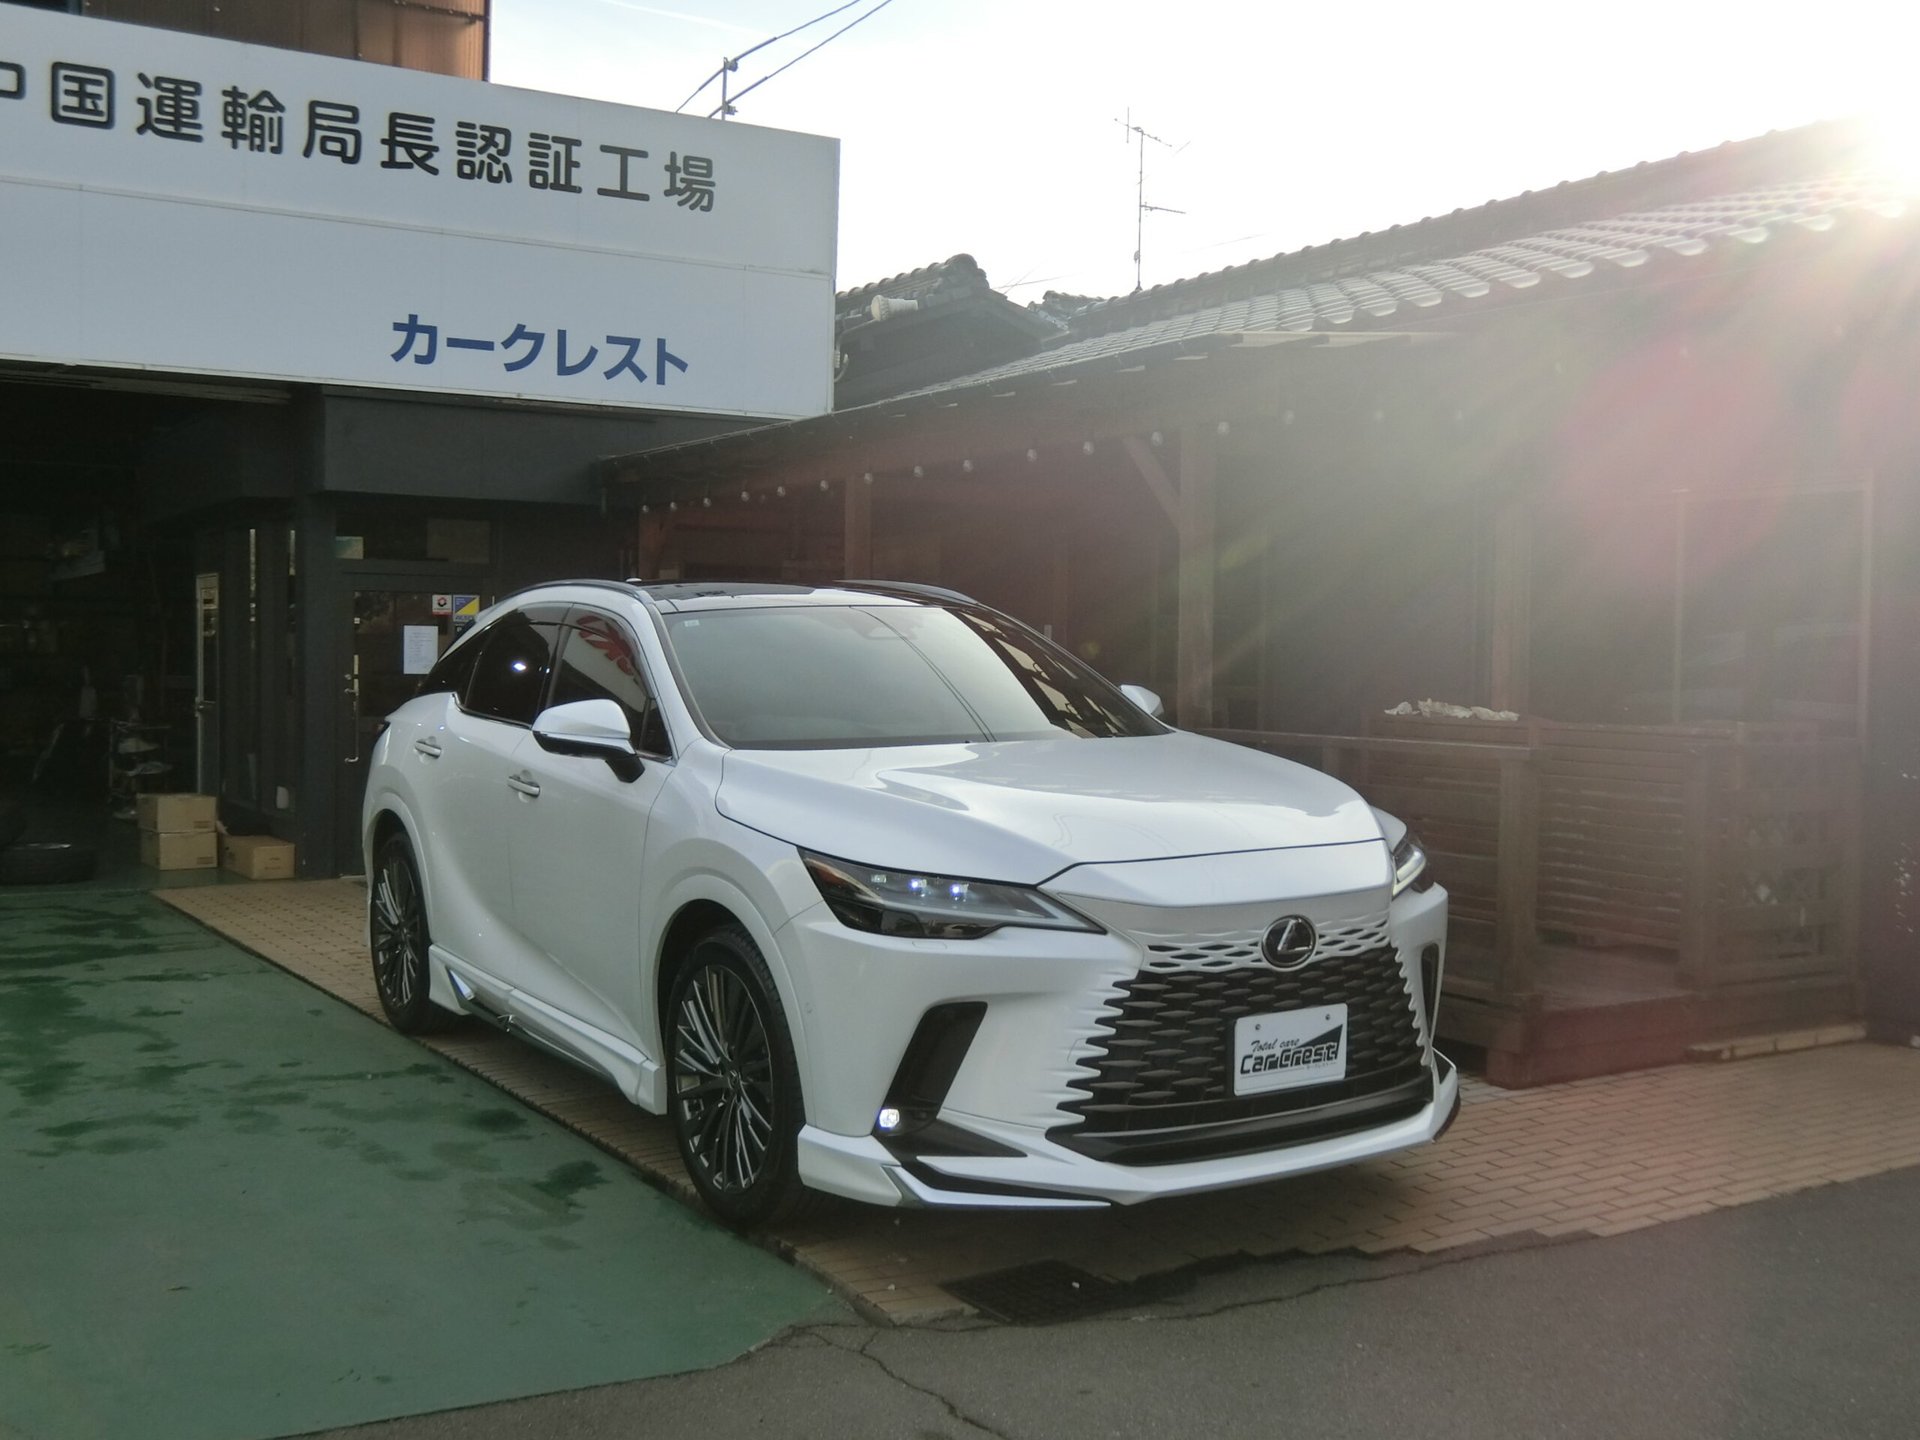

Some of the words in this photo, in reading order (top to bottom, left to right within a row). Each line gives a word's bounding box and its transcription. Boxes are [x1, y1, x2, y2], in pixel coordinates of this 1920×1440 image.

[391, 314, 689, 386] カークレスト
[1251, 1038, 1278, 1053] Total
[1279, 1039, 1300, 1049] care
